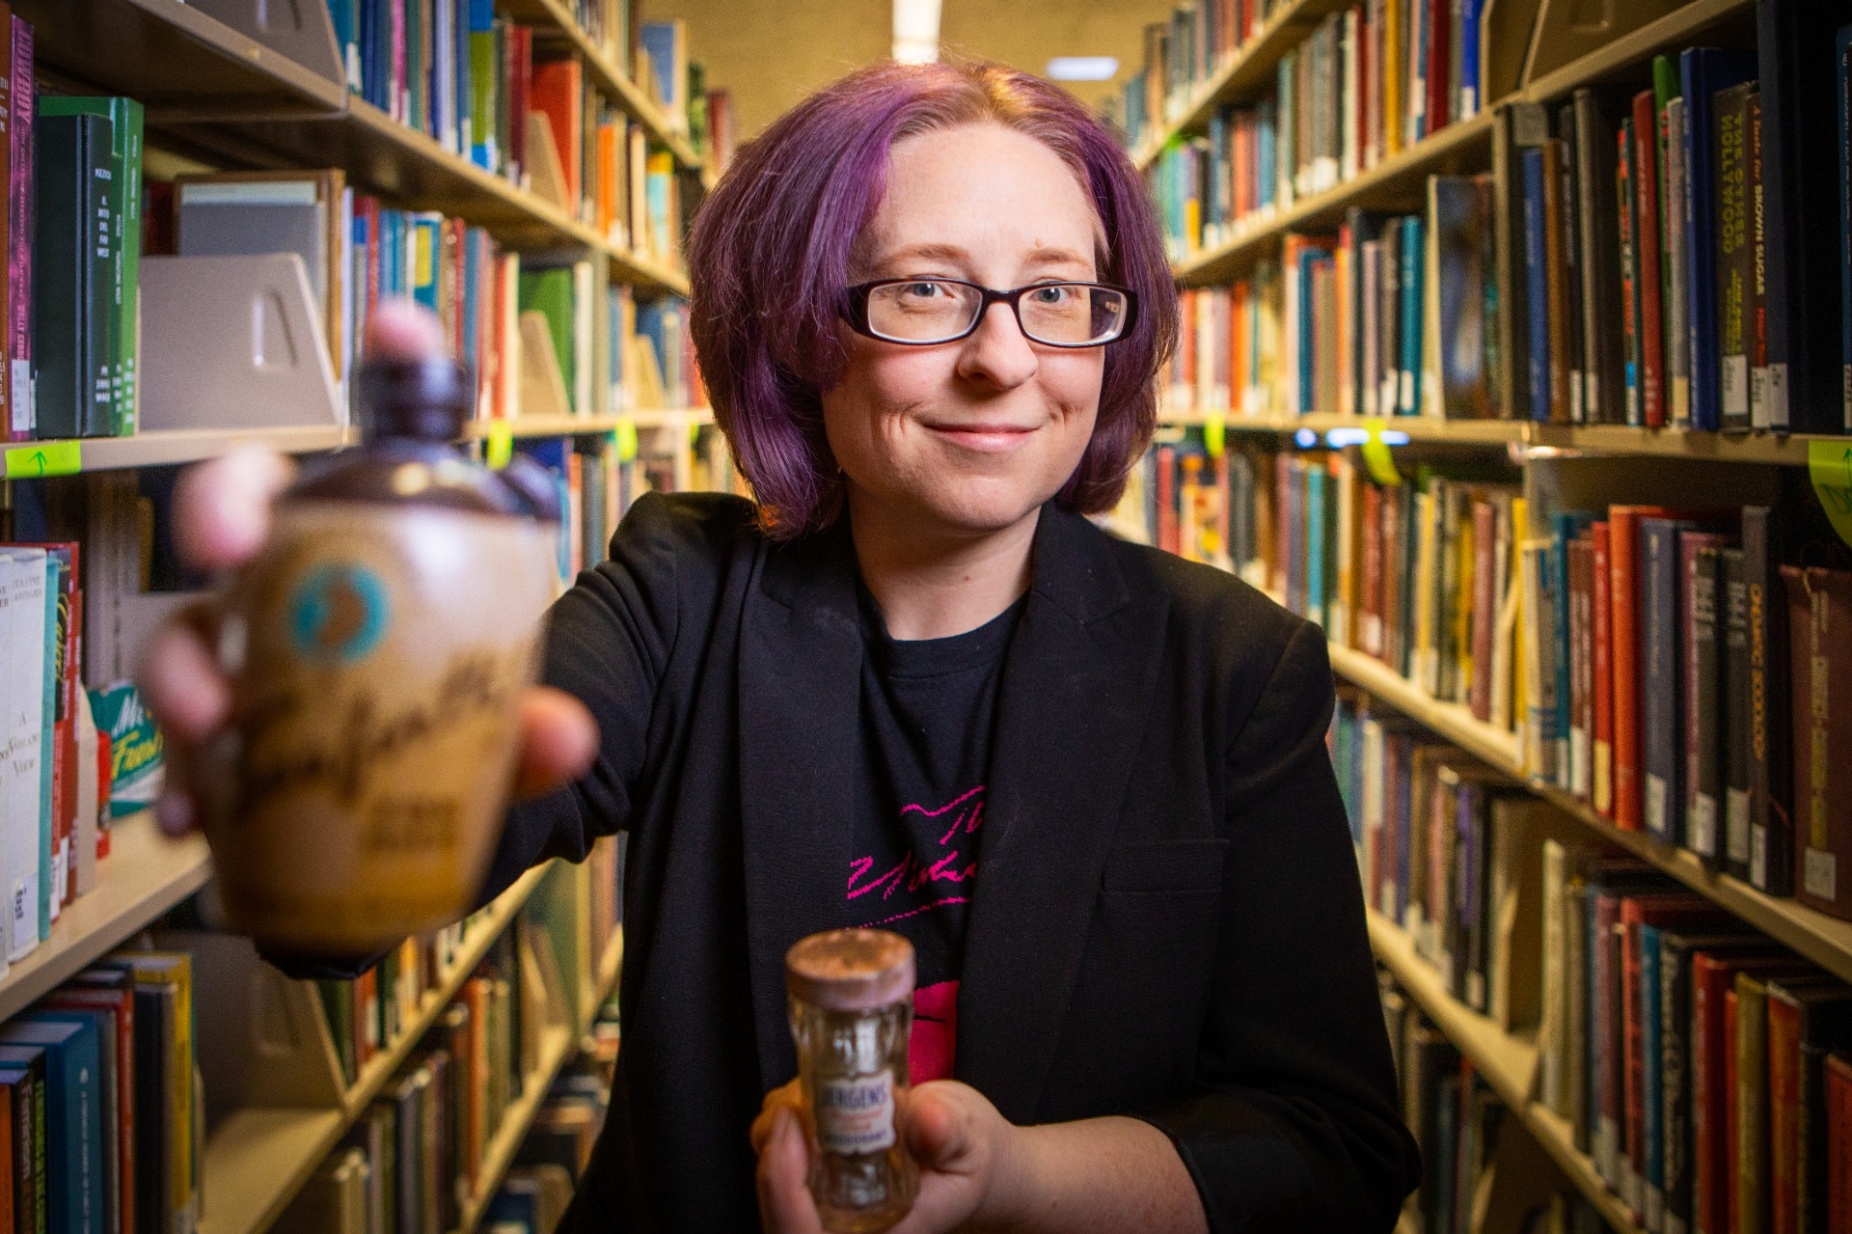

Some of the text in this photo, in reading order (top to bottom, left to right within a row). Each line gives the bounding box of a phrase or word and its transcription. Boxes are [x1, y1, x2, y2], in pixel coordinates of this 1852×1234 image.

[17, 30, 33, 125] COWBOY
[1721, 114, 1735, 254] HOLLYWOOD
[1734, 113, 1745, 247] THE OTHER
[1755, 184, 1764, 241] BROWN
[1756, 243, 1765, 296] SUGAR
